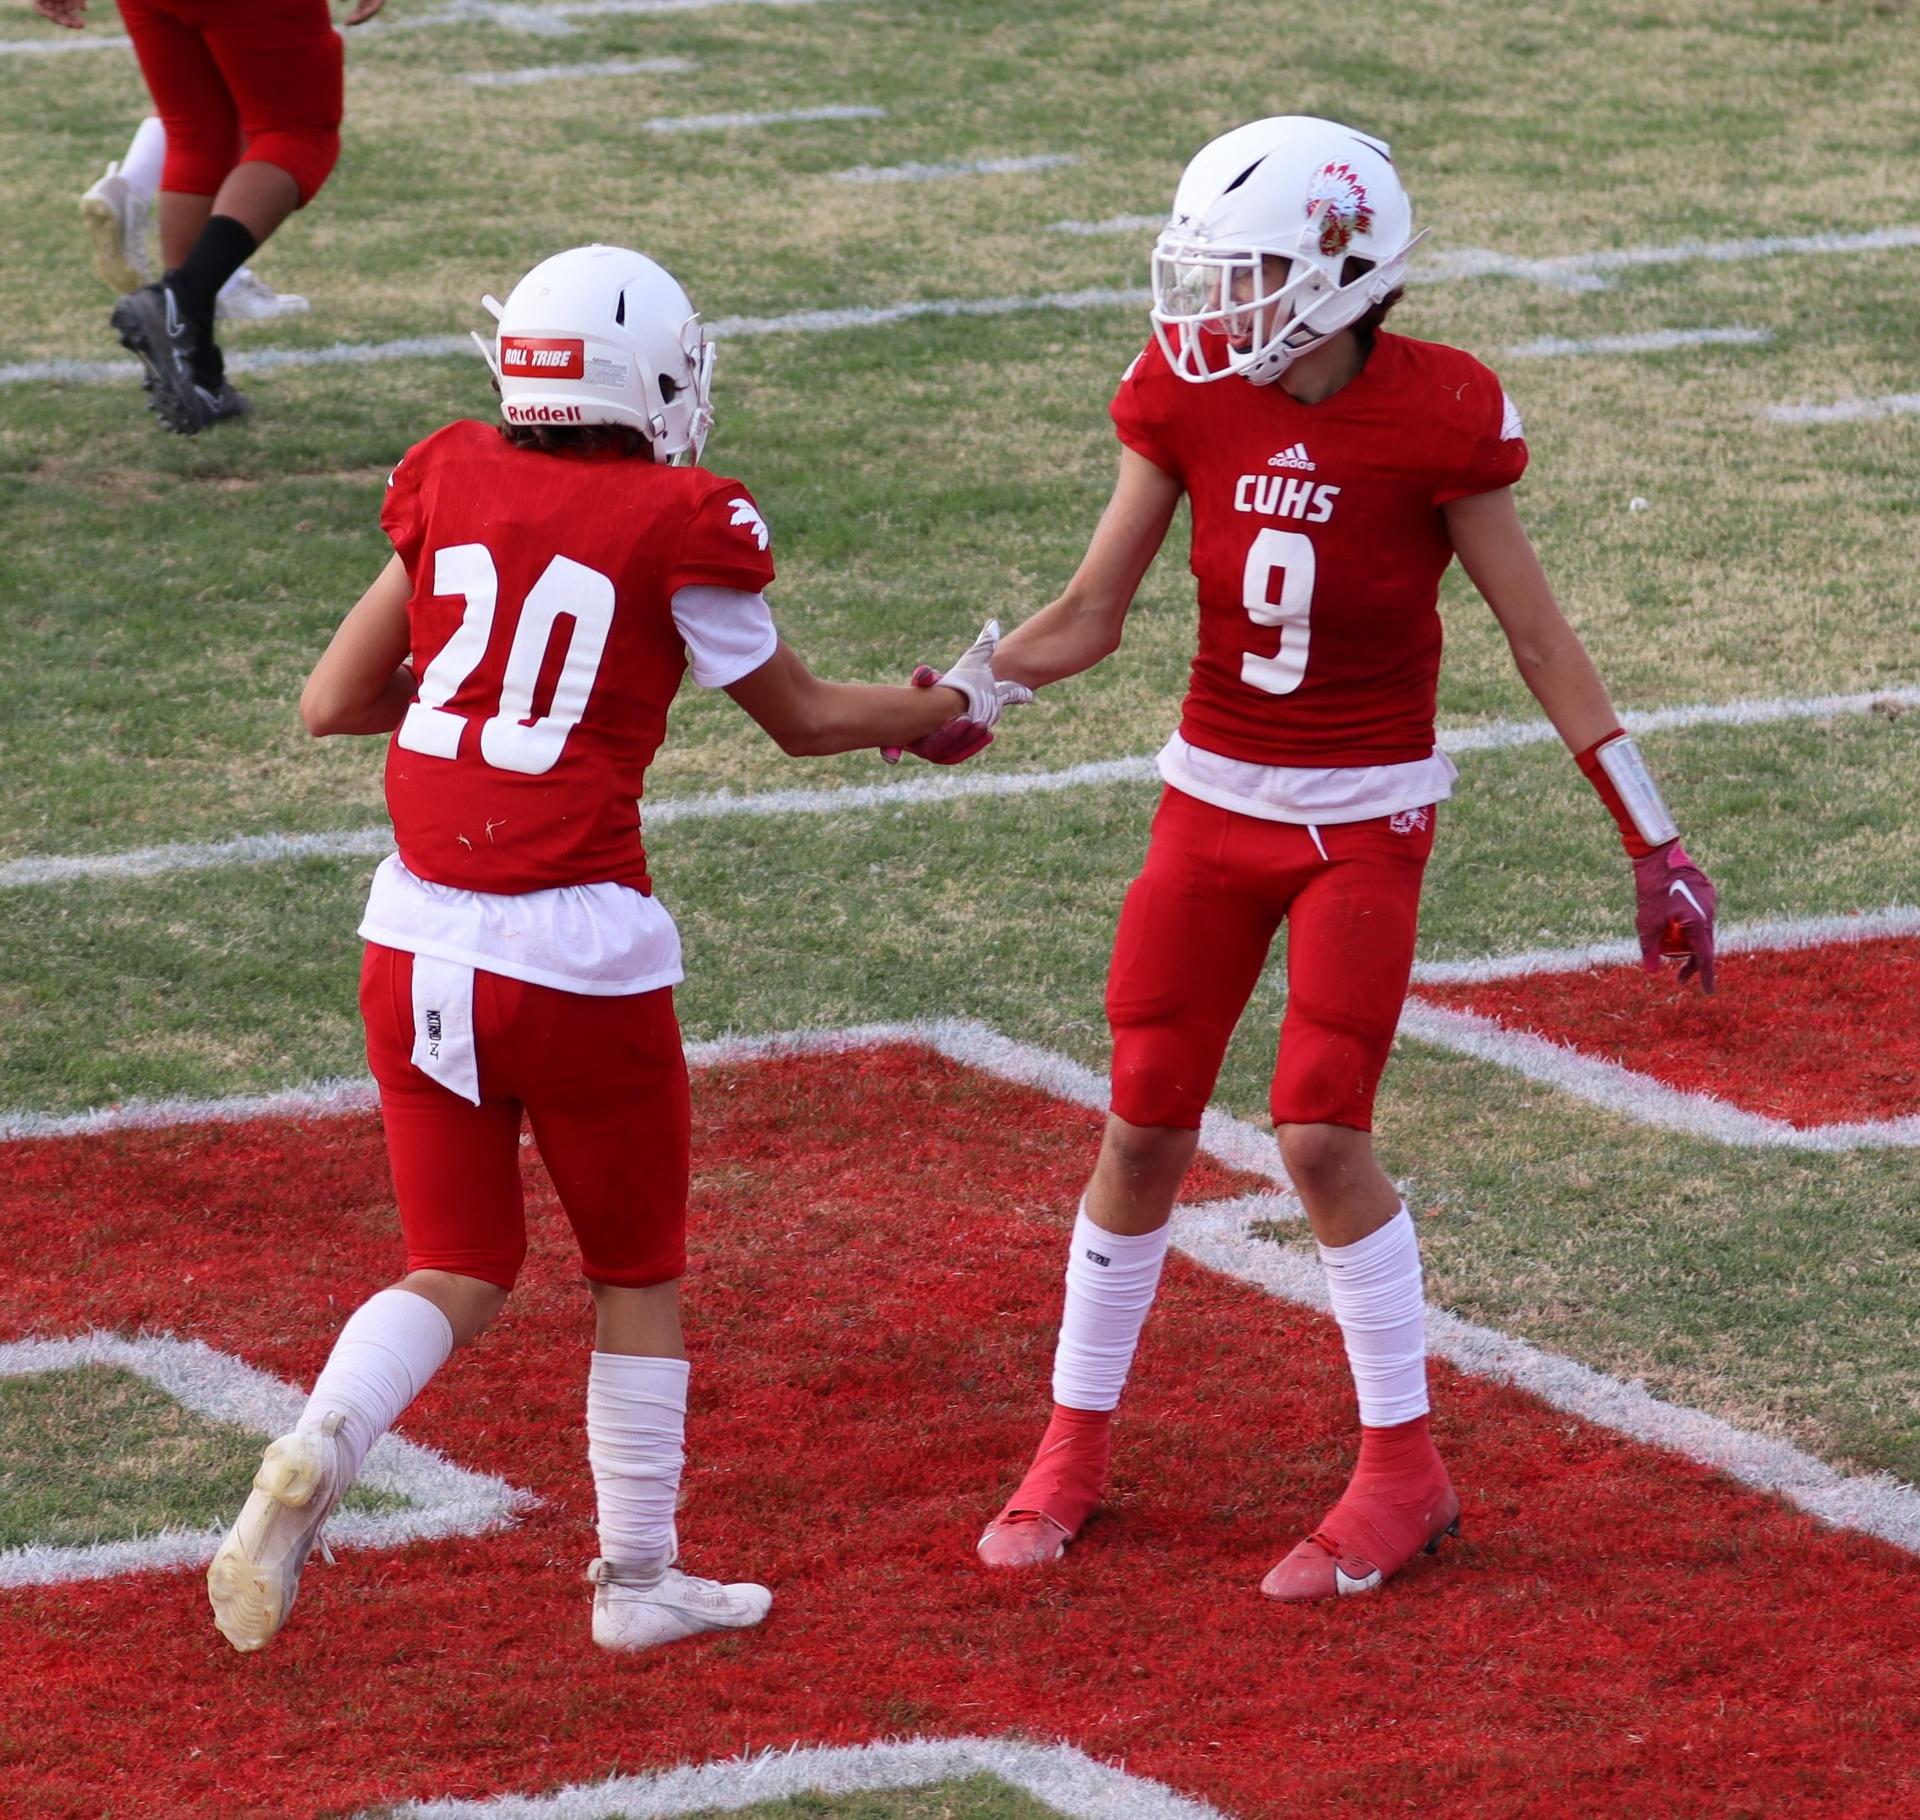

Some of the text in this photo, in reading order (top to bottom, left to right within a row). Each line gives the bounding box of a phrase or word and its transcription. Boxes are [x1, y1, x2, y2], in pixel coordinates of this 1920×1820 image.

[504, 348, 572, 367] ROLL TRIBE
[508, 406, 582, 422] Riddell
[1267, 457, 1316, 472] adidas
[1234, 474, 1342, 523] CUHS
[1240, 527, 1316, 695] 9
[397, 542, 616, 776] 20
